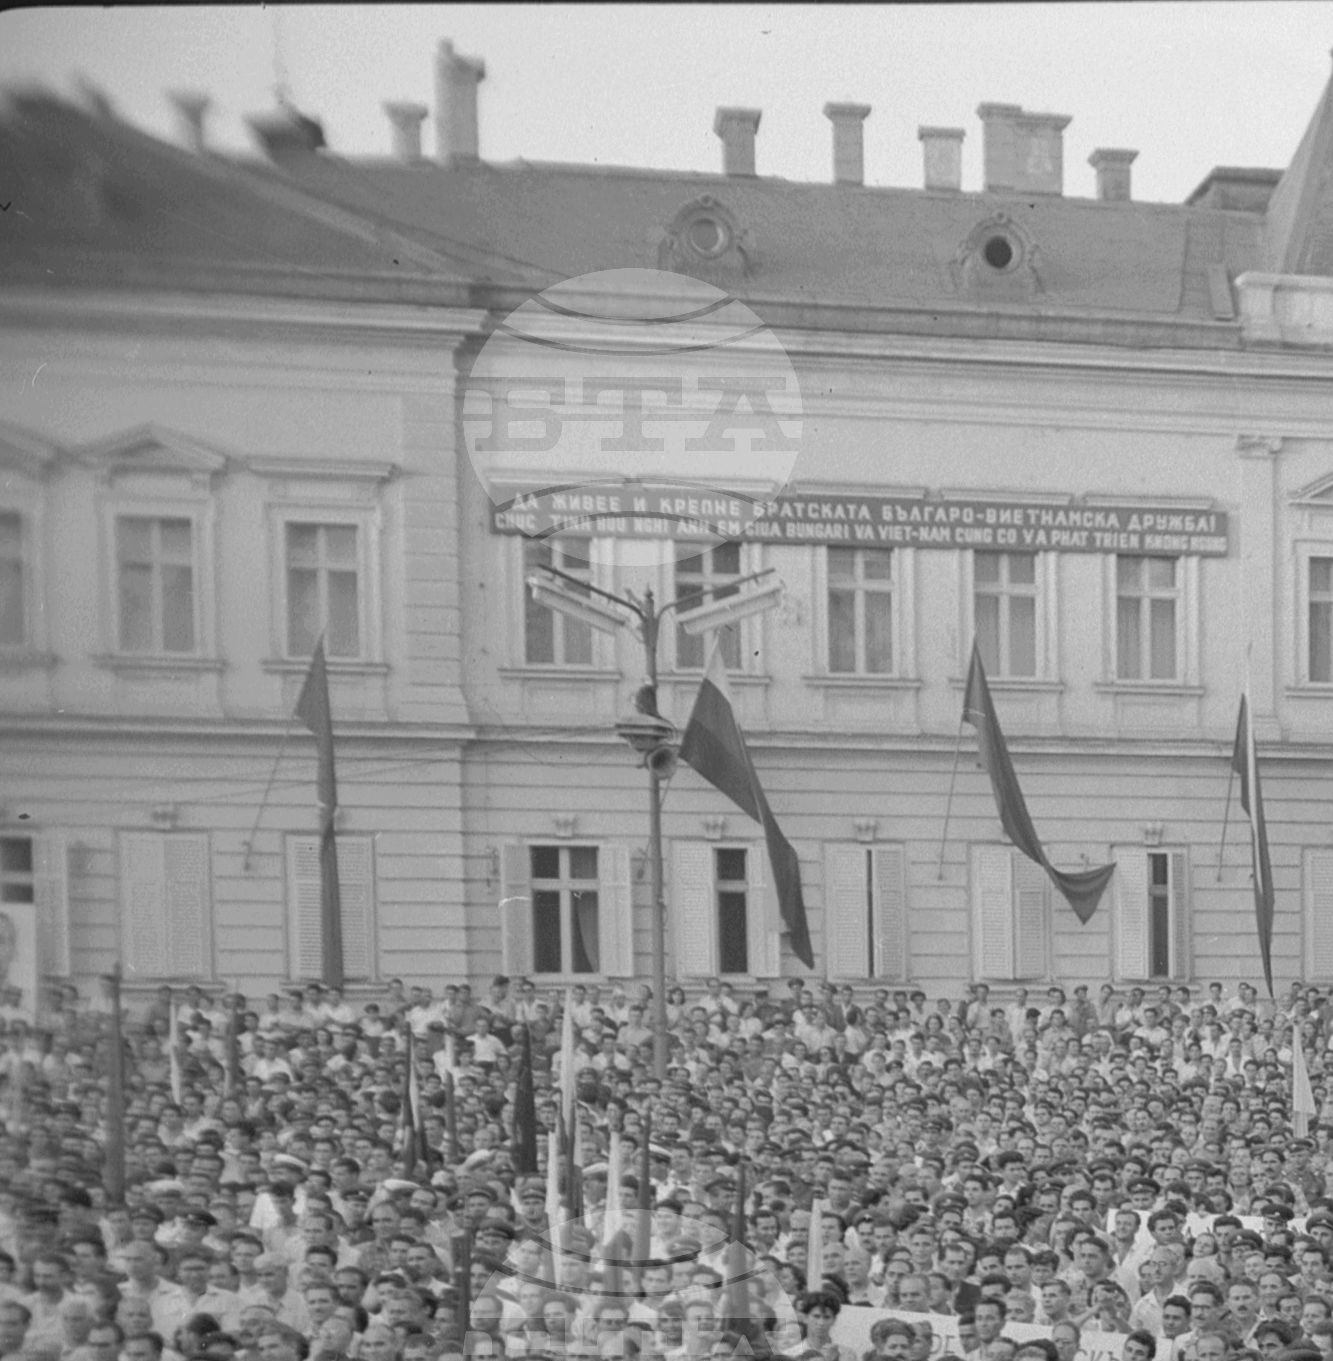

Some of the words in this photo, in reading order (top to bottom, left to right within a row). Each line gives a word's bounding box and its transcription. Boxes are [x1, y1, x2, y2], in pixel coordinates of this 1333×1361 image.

[511, 493, 538, 511] ДА
[551, 494, 621, 512] ЖИВЕЕ
[634, 496, 648, 512] И
[660, 497, 741, 517] КРЕПНЕ
[752, 501, 870, 521] БРАТСКАТА
[881, 505, 1121, 529] БЪЛГАРО-ВИЕТНАМСКА
[1127, 513, 1217, 533] ДРУЖБА!
[744, 521, 782, 538] GIUA
[786, 522, 850, 539] BUNGARI
[854, 524, 875, 540] VA
[878, 525, 952, 543] VIET-NAM
[954, 527, 993, 544] CUNG
[996, 528, 1017, 544] CO
[1022, 528, 1048, 545] VA
[1050, 530, 1089, 547] PHAT
[1093, 532, 1140, 549] TRIEN
